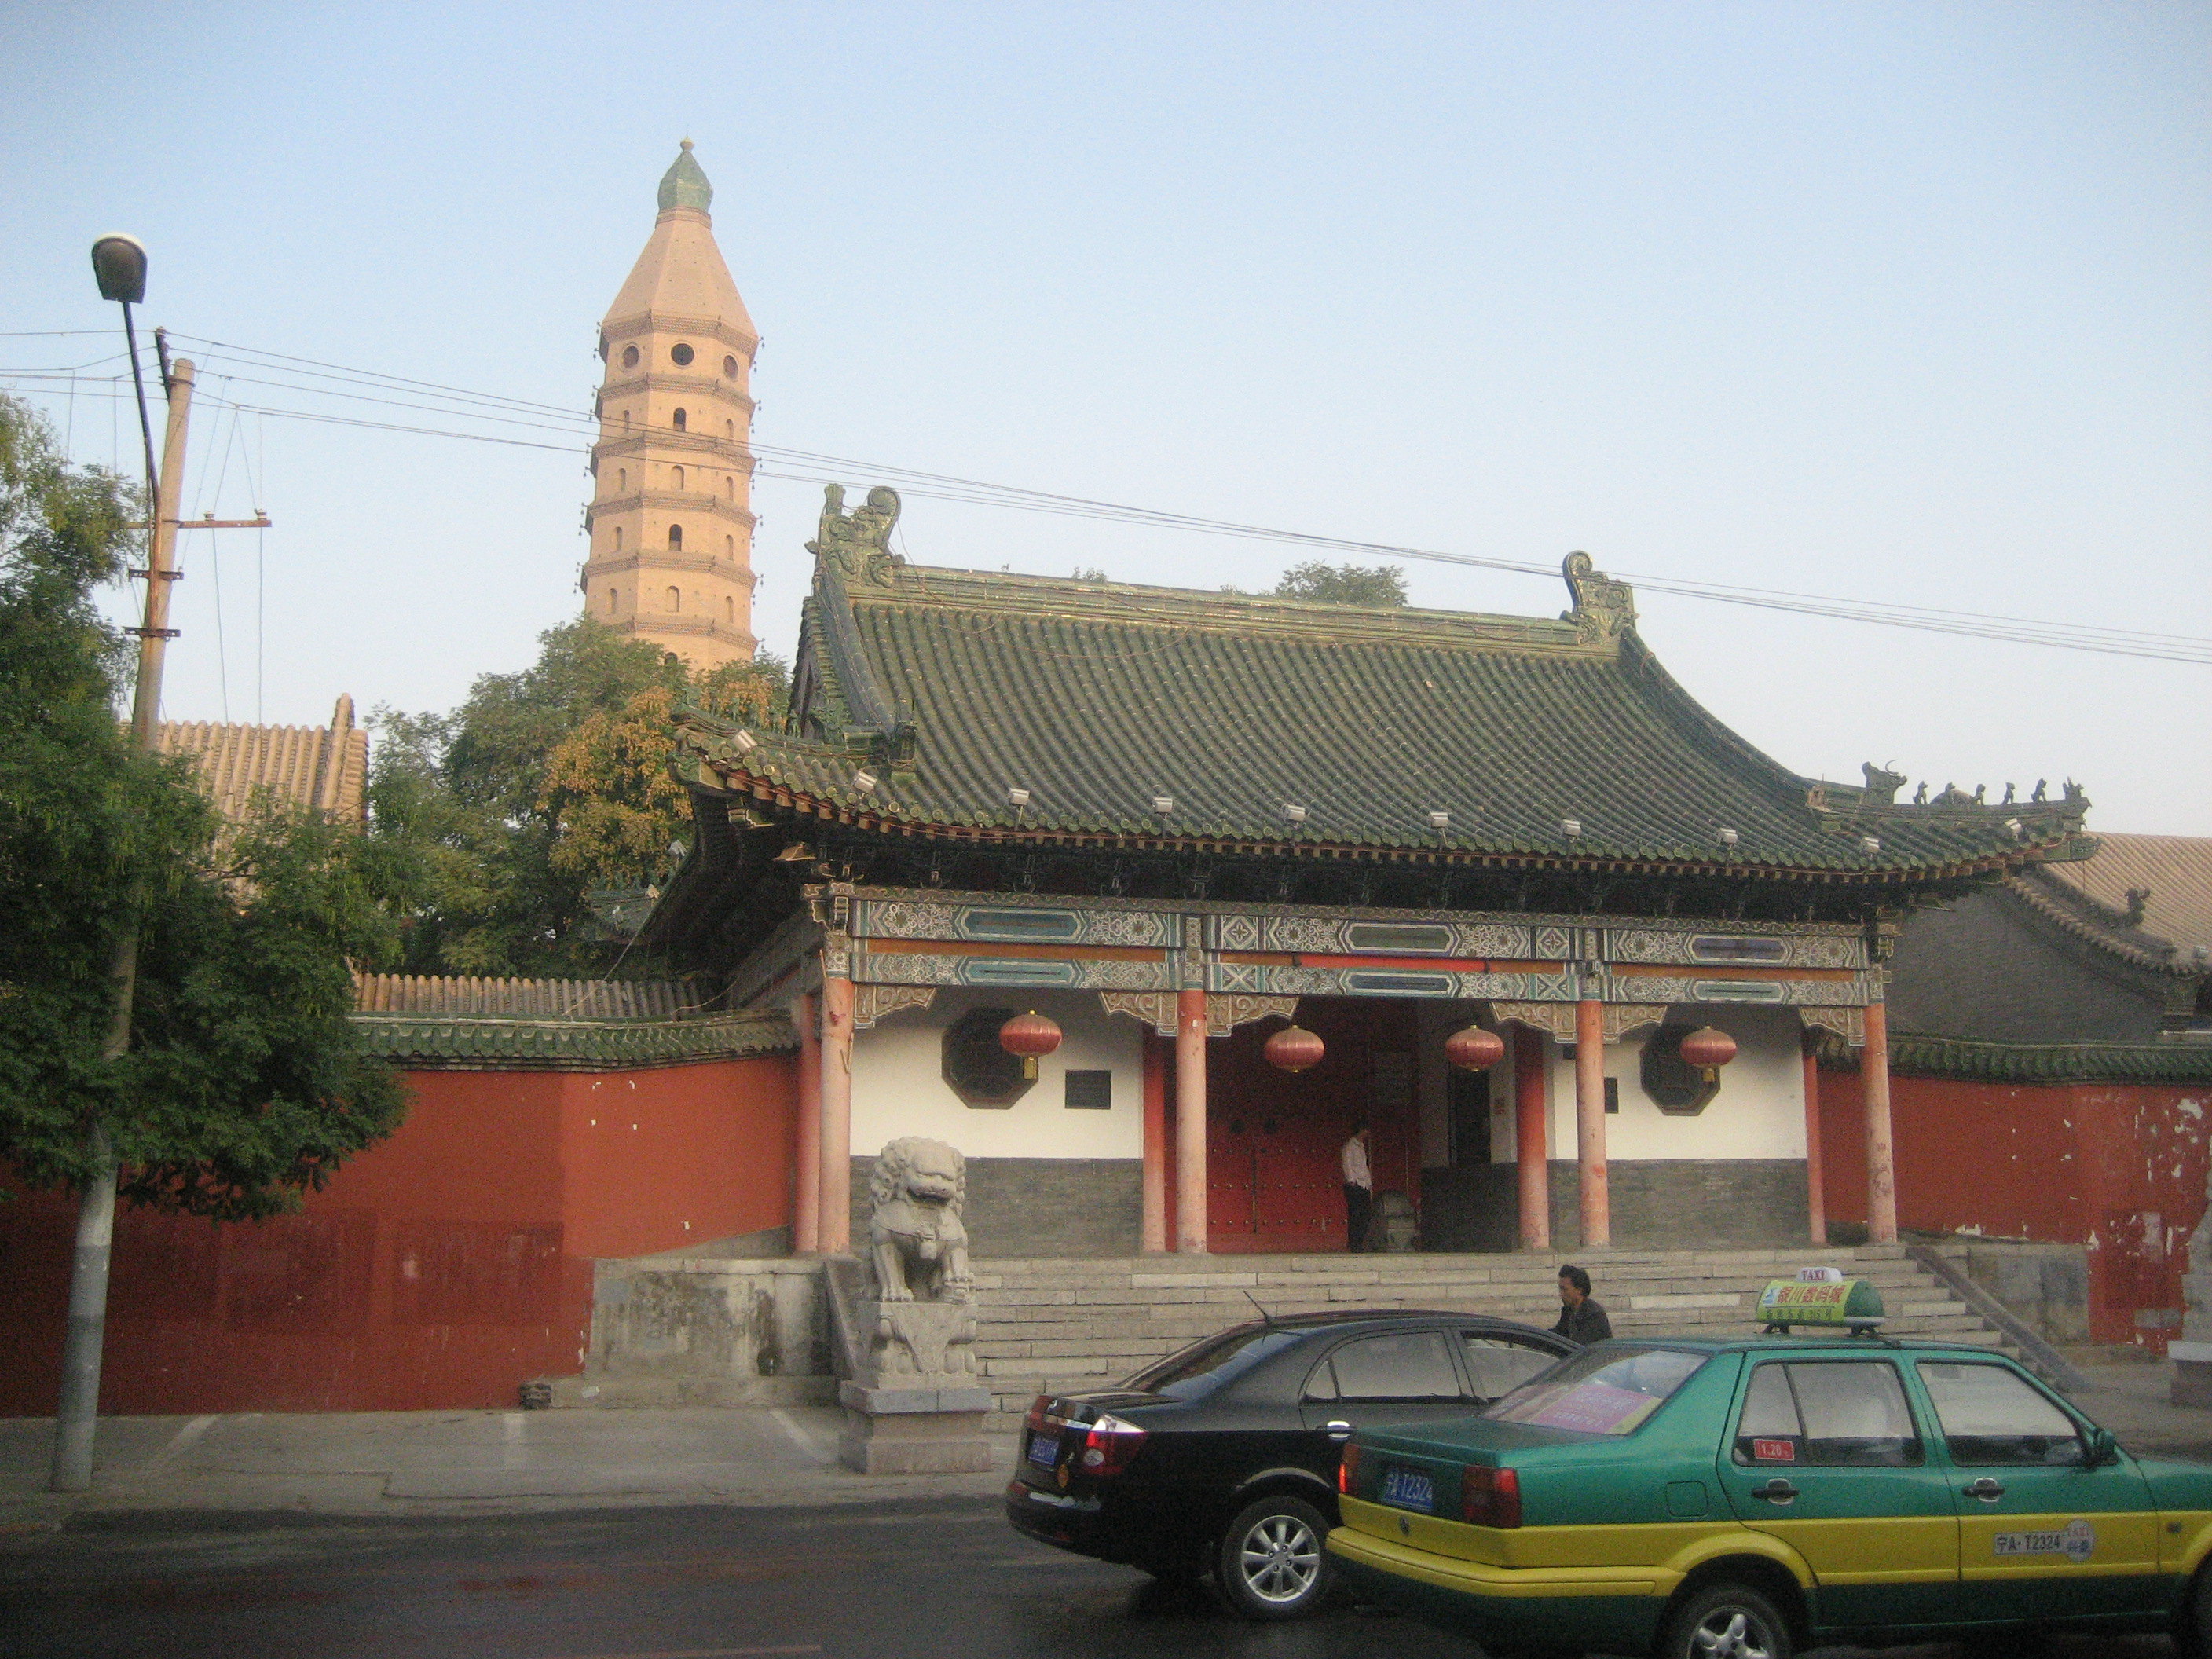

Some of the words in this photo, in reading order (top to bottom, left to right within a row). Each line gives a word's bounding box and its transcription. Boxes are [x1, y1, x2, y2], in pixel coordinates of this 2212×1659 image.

[1802, 1270, 1826, 1281] TAXI
[1778, 1285, 1847, 1304] 银川数码城
